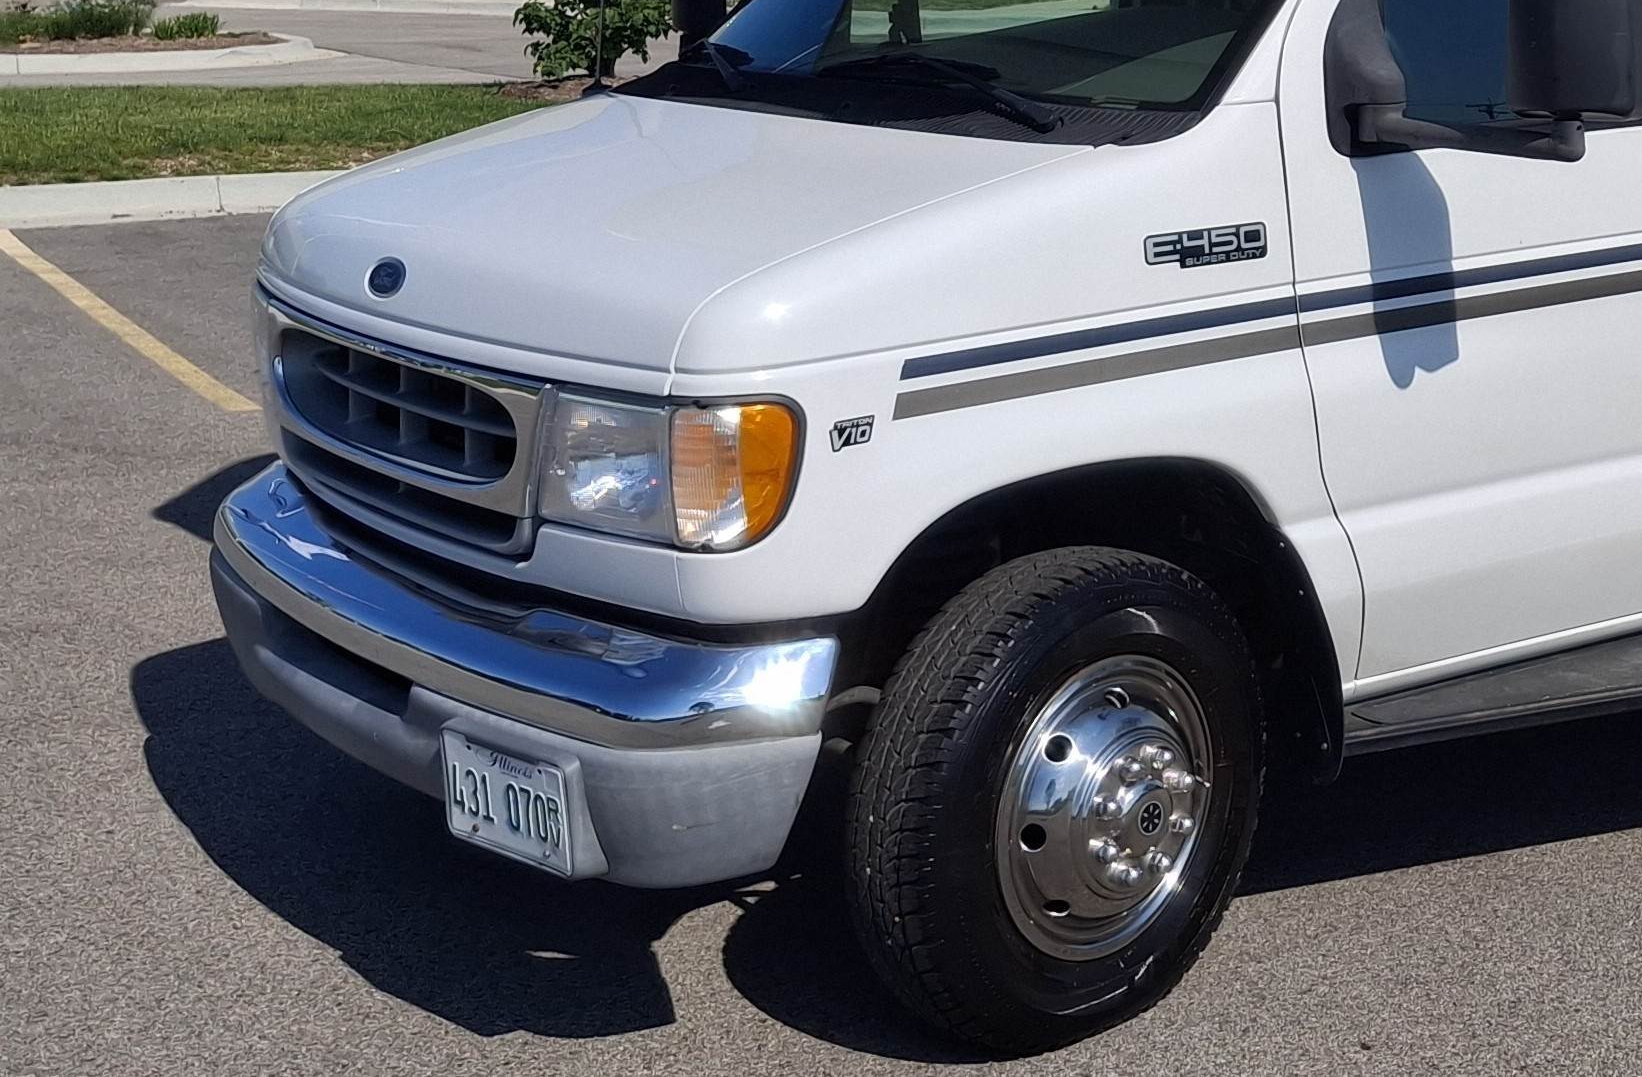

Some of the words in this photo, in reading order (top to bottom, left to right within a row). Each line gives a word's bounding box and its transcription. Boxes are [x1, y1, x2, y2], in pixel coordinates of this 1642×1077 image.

[1185, 254, 1226, 266] SUPER
[1229, 249, 1263, 260] DUTY
[835, 417, 874, 429] TRITON
[831, 425, 870, 451] V10
[481, 751, 534, 779] Illinois
[452, 761, 497, 824] 431
